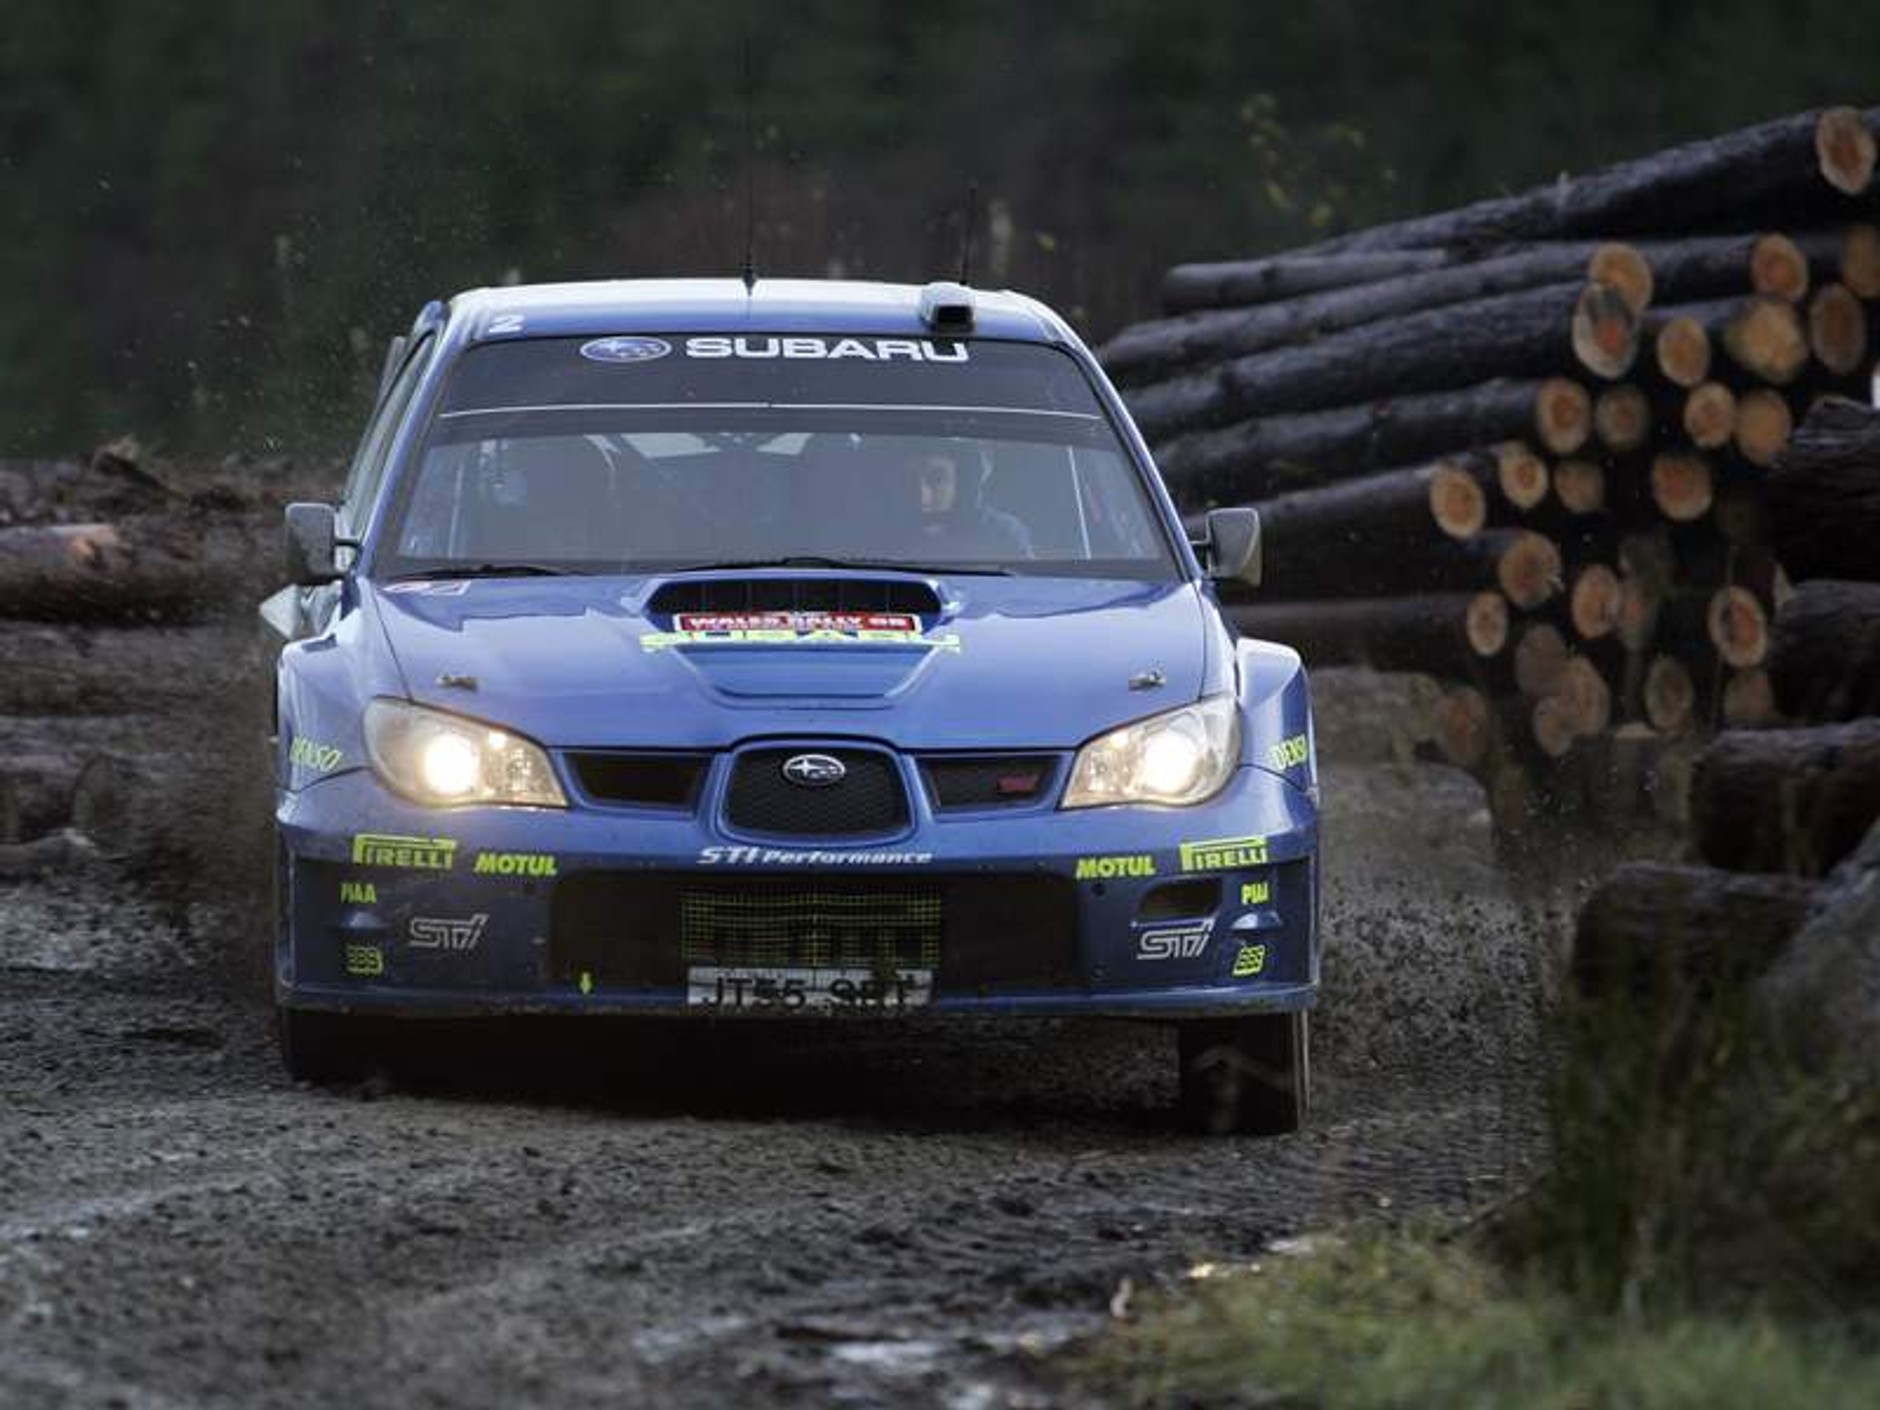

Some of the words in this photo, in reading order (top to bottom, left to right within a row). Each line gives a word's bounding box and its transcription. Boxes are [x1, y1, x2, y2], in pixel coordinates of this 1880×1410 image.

[686, 338, 969, 361] SUBARU
[353, 833, 457, 869] PIRELLI
[698, 846, 760, 864] STI
[762, 849, 933, 865] Performance
[1180, 837, 1268, 872] PIRELLI
[474, 853, 558, 876] MOTUL
[1076, 856, 1156, 880] MOTUL
